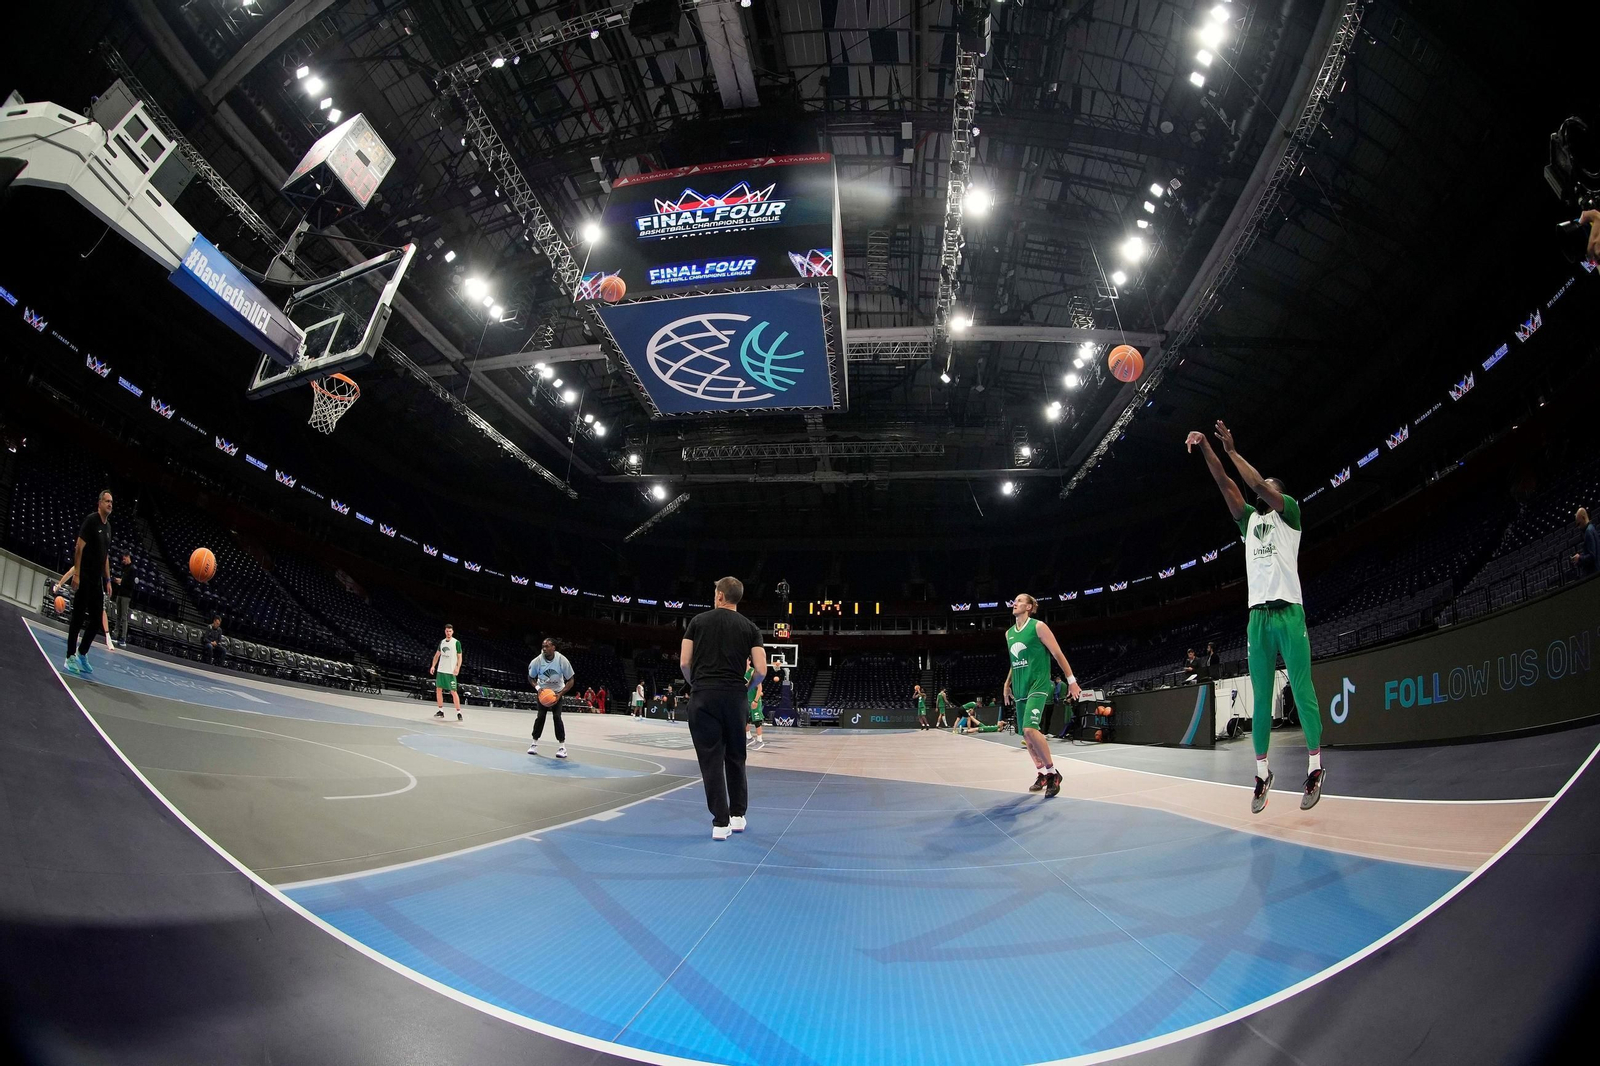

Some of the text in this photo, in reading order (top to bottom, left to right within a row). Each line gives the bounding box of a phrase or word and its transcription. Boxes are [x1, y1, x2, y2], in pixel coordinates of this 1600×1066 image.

[702, 162, 749, 171] ALTABANKA
[778, 156, 825, 164] ALTABANKA
[631, 171, 674, 182] ALTABANKA
[638, 201, 786, 231] FINAL FOUR
[639, 226, 691, 237] BASKETBALL
[692, 218, 744, 230] CHAMPIONS
[745, 215, 780, 225] LEAGUE
[649, 259, 757, 280] FINAL FOUR
[650, 276, 689, 285] BASKETBALL
[689, 271, 727, 281] CHAMPIONS
[184, 248, 272, 335] #BasketballCL
[1384, 631, 1591, 710] FOLLOW US ON
